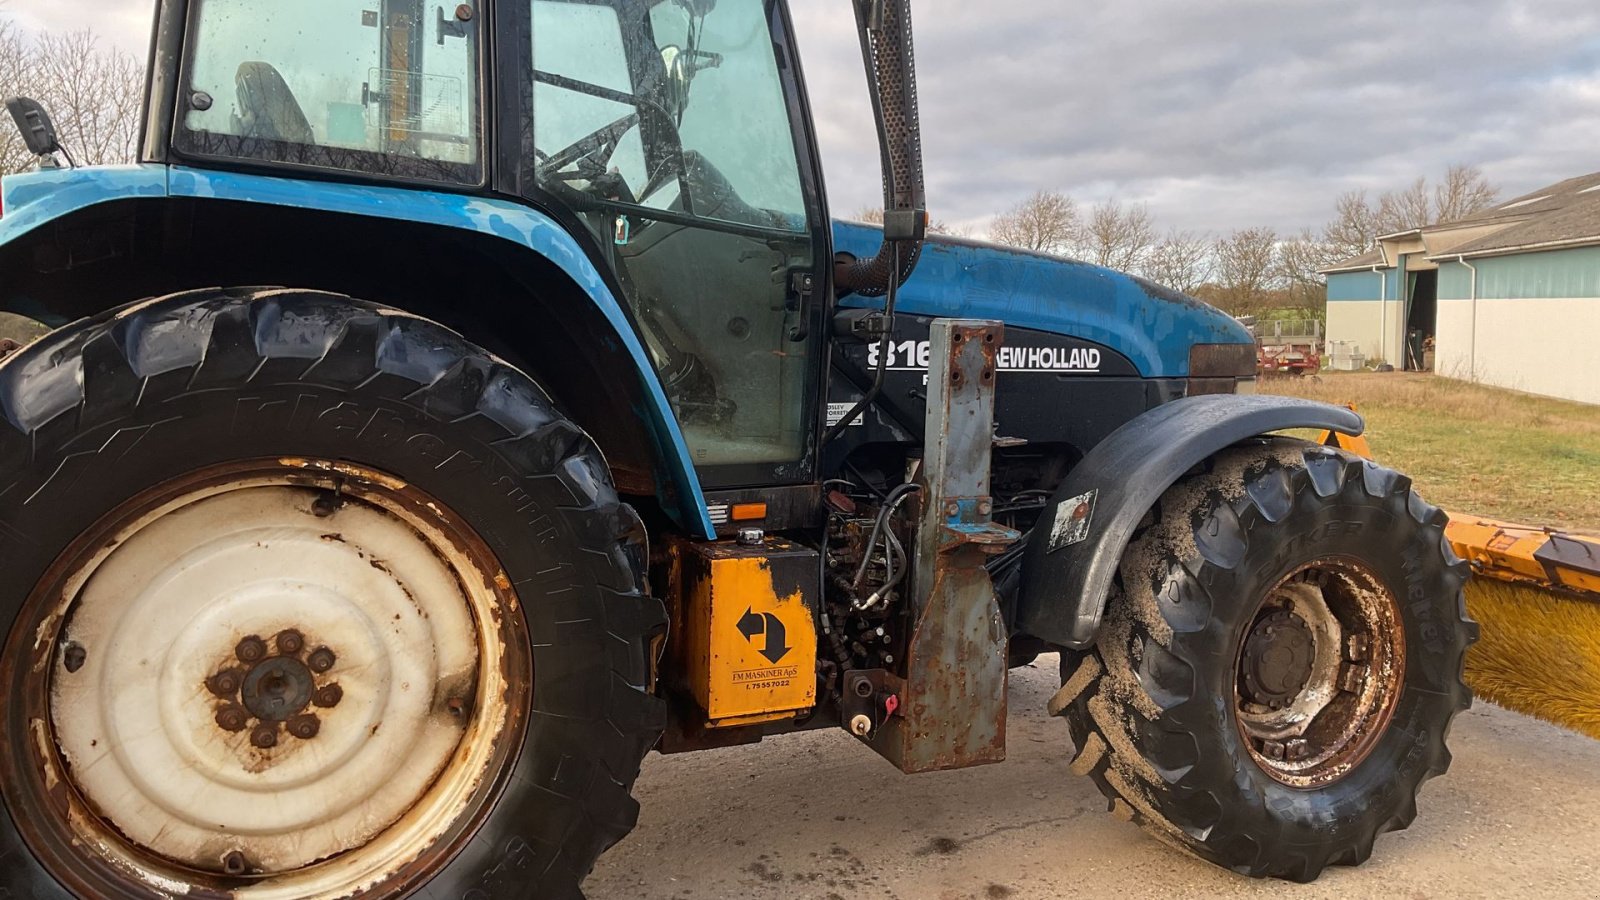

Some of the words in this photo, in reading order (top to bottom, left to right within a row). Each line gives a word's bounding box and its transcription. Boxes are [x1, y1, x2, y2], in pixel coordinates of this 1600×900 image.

[1028, 347, 1100, 369] HOLLAND
[732, 672, 744, 681] FM
[745, 669, 783, 680] MASKINER
[784, 667, 798, 679] ApS
